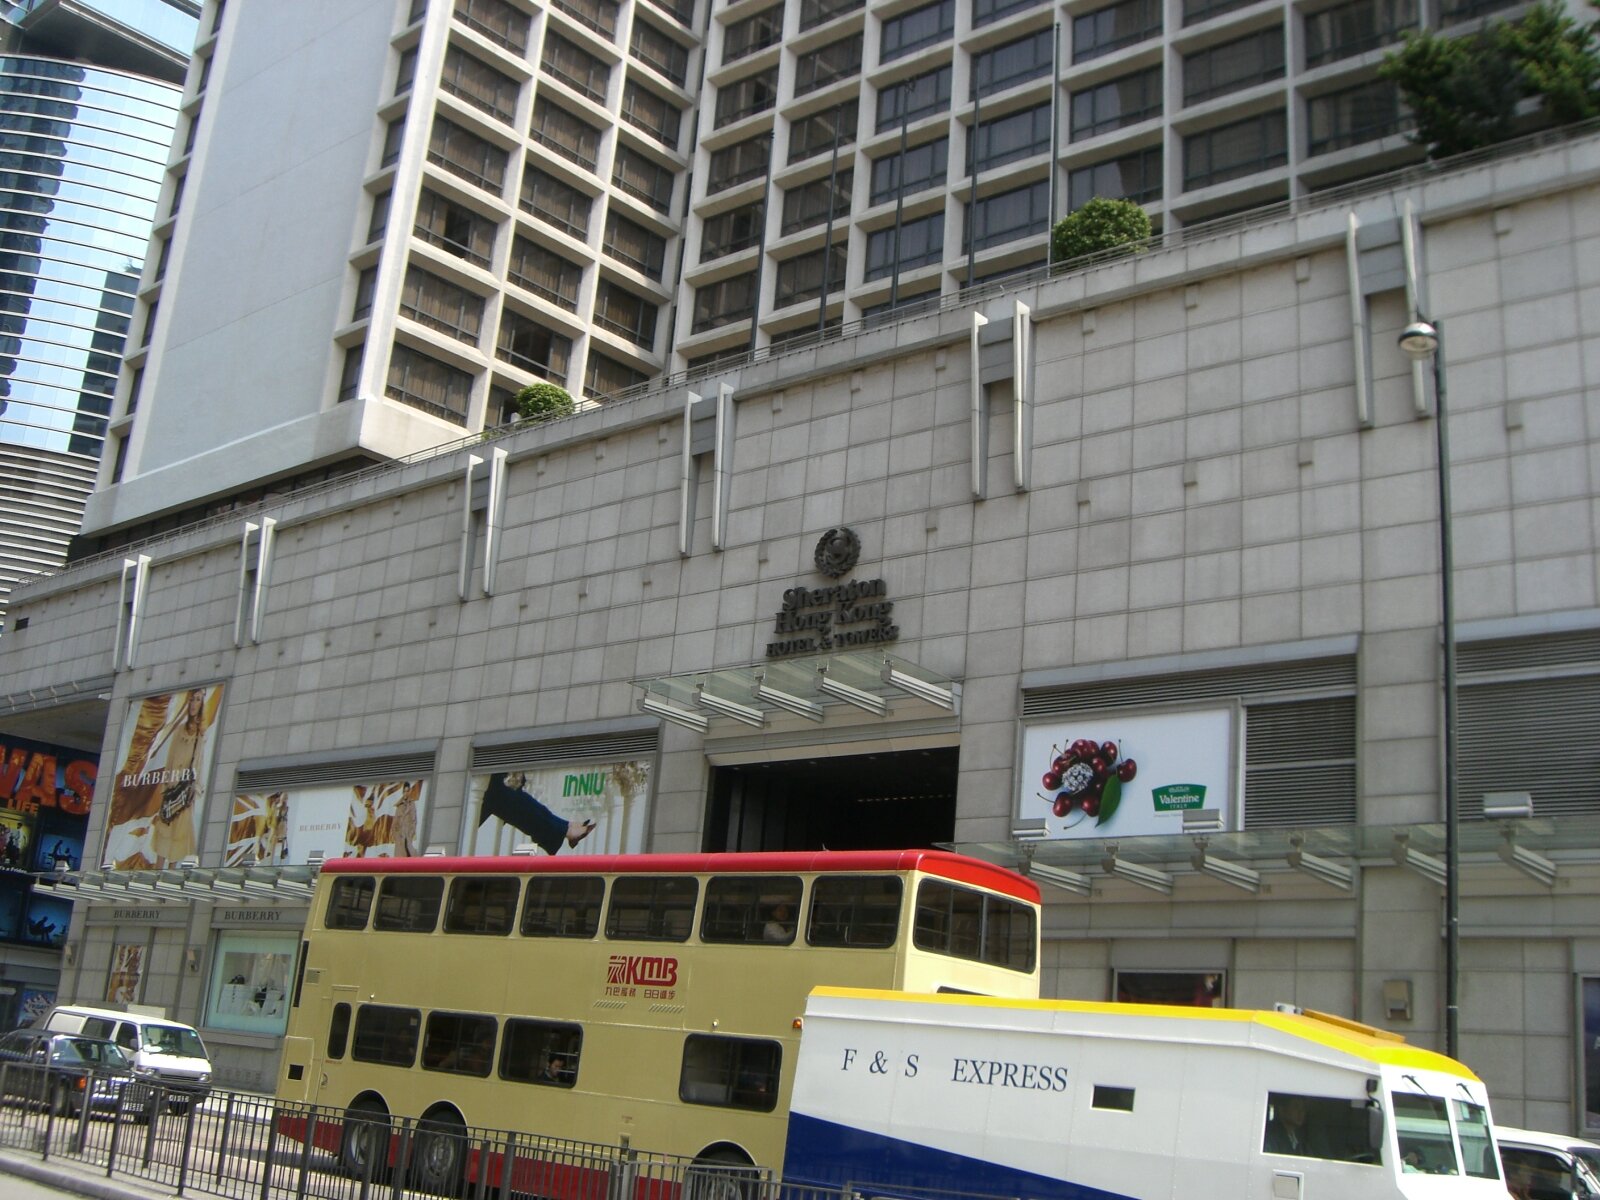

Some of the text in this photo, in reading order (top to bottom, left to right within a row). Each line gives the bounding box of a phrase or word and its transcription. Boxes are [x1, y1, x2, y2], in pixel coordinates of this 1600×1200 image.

[782, 579, 886, 611] Sheraton
[774, 601, 894, 635] Hong Kong
[834, 625, 899, 647] TOWERS
[123, 767, 197, 788] BURBERRY
[7, 798, 39, 816] LIFE
[1159, 794, 1200, 804] Valentine
[299, 823, 342, 832] BURBERRY
[113, 909, 161, 920] BURBERRY
[224, 911, 282, 921] BURBERRY
[840, 1048, 1069, 1092] F & S EXPRESS
